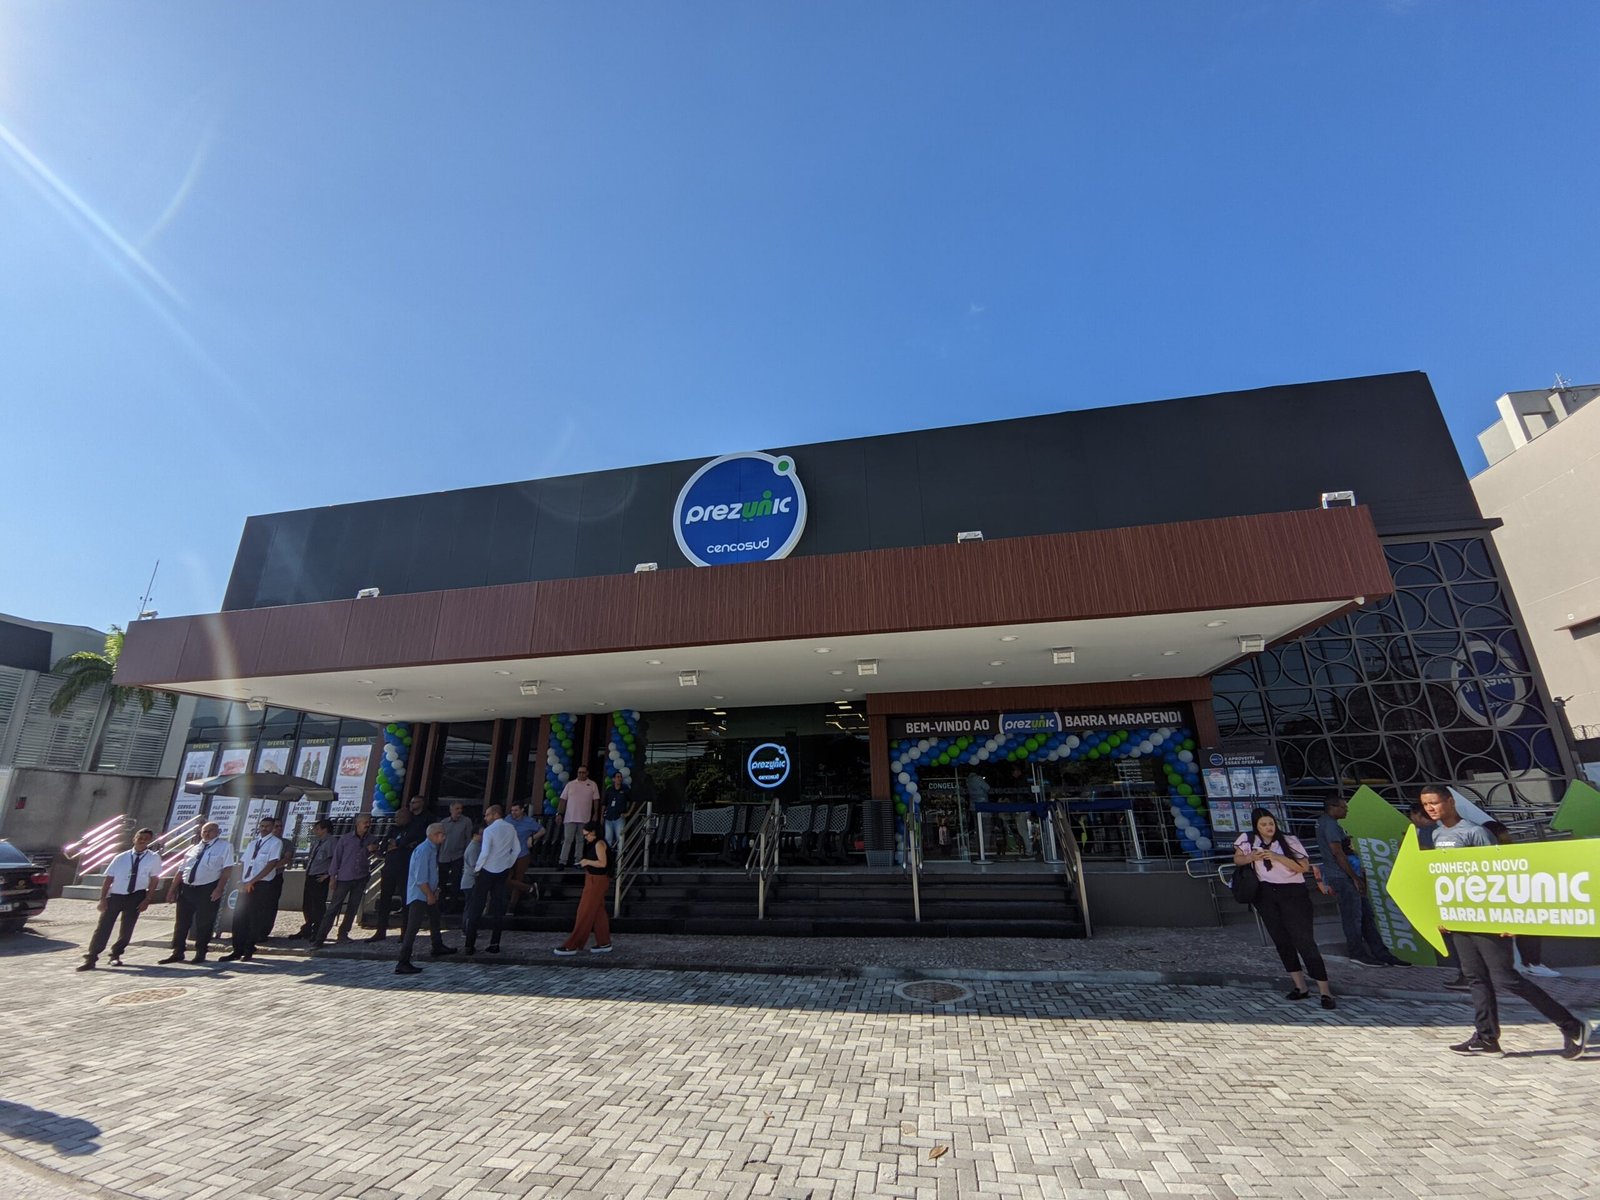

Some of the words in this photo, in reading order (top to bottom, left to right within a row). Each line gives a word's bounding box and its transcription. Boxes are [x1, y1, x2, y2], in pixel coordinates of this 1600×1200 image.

[685, 490, 792, 524] prezunic
[706, 537, 770, 554] cencosud
[905, 719, 971, 733] BEM-VINDO
[973, 719, 990, 731] AO
[1004, 714, 1055, 731] prezunic
[1065, 714, 1107, 727] BARRA
[1108, 711, 1182, 726] MARAPENDI
[1429, 861, 1479, 876] CONHEÇA
[1481, 860, 1490, 872] O
[1492, 858, 1529, 872] NOVO
[1358, 838, 1376, 876] BARRA
[1368, 879, 1395, 950] MARAPENDI
[1439, 906, 1487, 922] BARRA
[1488, 907, 1596, 925] MARAPENDI
